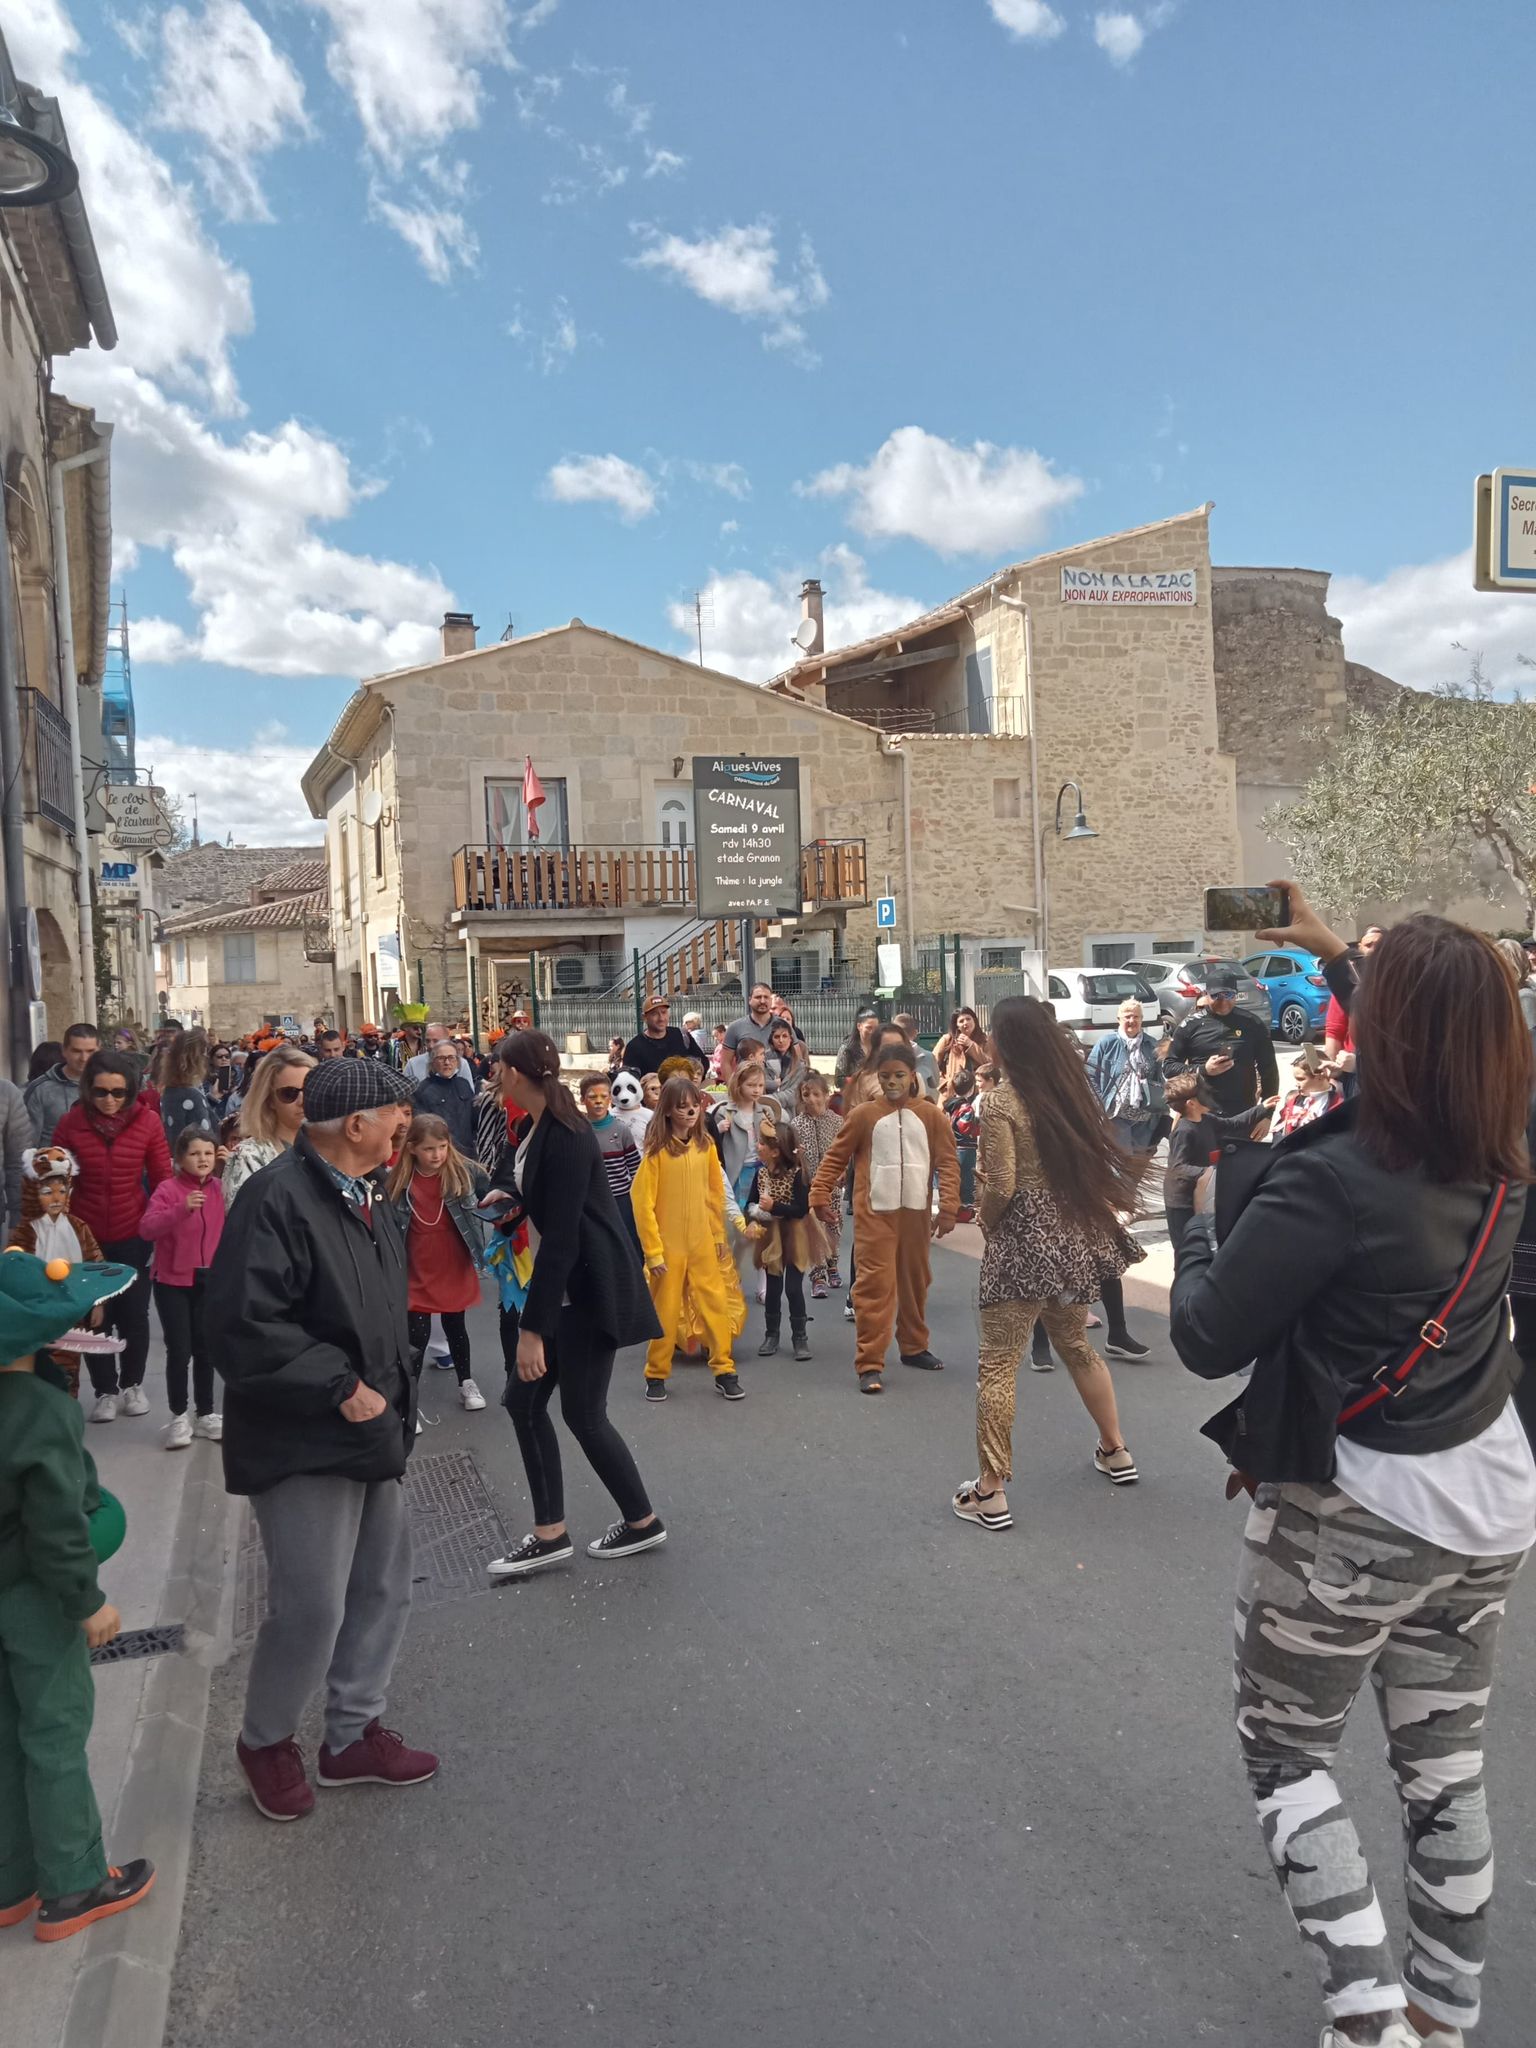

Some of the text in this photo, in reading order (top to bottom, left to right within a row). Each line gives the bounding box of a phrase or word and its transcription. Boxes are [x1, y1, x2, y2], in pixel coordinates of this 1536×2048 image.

[1064, 569, 1192, 589] NON A LA ZAC
[1064, 589, 1193, 602] NON AUX EXPROPRIATIONS
[712, 761, 782, 775] Aigues-Vives
[125, 804, 140, 815] de
[708, 788, 780, 819] CARNAVAL
[710, 823, 785, 834] Samedi 9 avril
[722, 838, 772, 849] rdv 14h30
[717, 852, 781, 863] stade Granon
[714, 875, 740, 885] Thème
[748, 875, 756, 885] la
[757, 875, 783, 888] jungle
[881, 903, 891, 922] P
